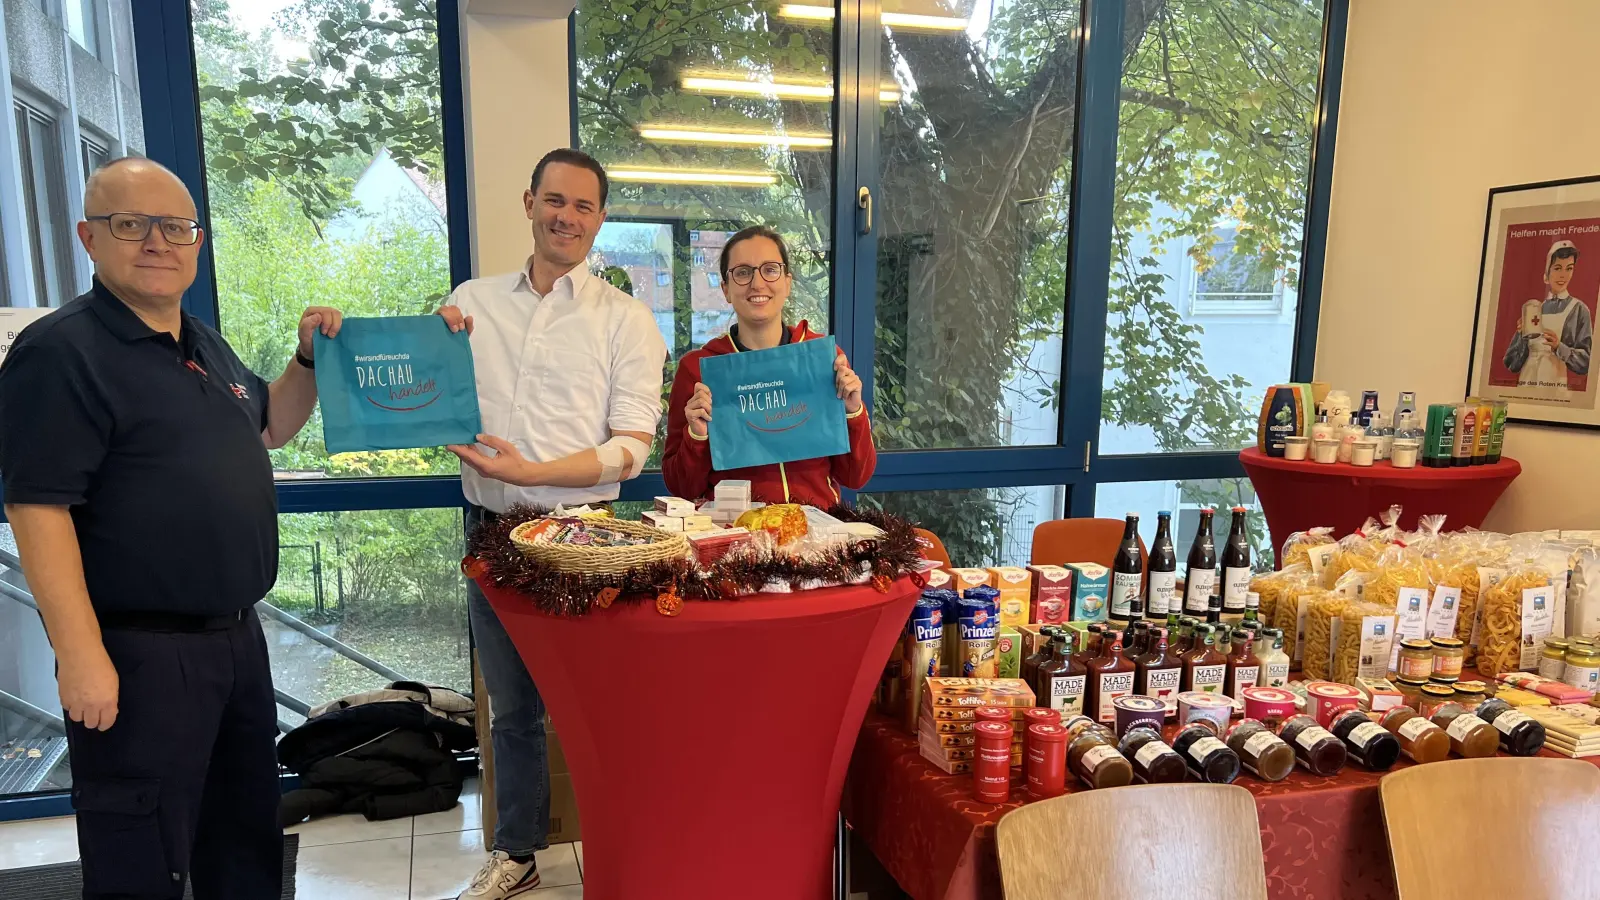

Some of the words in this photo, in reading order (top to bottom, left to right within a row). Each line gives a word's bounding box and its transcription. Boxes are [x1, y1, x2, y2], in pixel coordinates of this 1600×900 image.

[1510, 229, 1537, 238] Helfen
[1538, 226, 1566, 236] macht
[356, 364, 413, 389] DACHAU
[1538, 380, 1556, 388] Roten
[389, 378, 437, 401] handelt
[738, 389, 787, 414] DACHAU
[1151, 672, 1178, 682] MADE
[1196, 668, 1223, 678] MADE
[1237, 668, 1257, 676] MADE
[1055, 679, 1083, 689] MADE
[1103, 675, 1131, 686] MADE
[1102, 684, 1115, 692] FOR
[1115, 682, 1131, 690] MEAT
[957, 696, 987, 706] Toffifee
